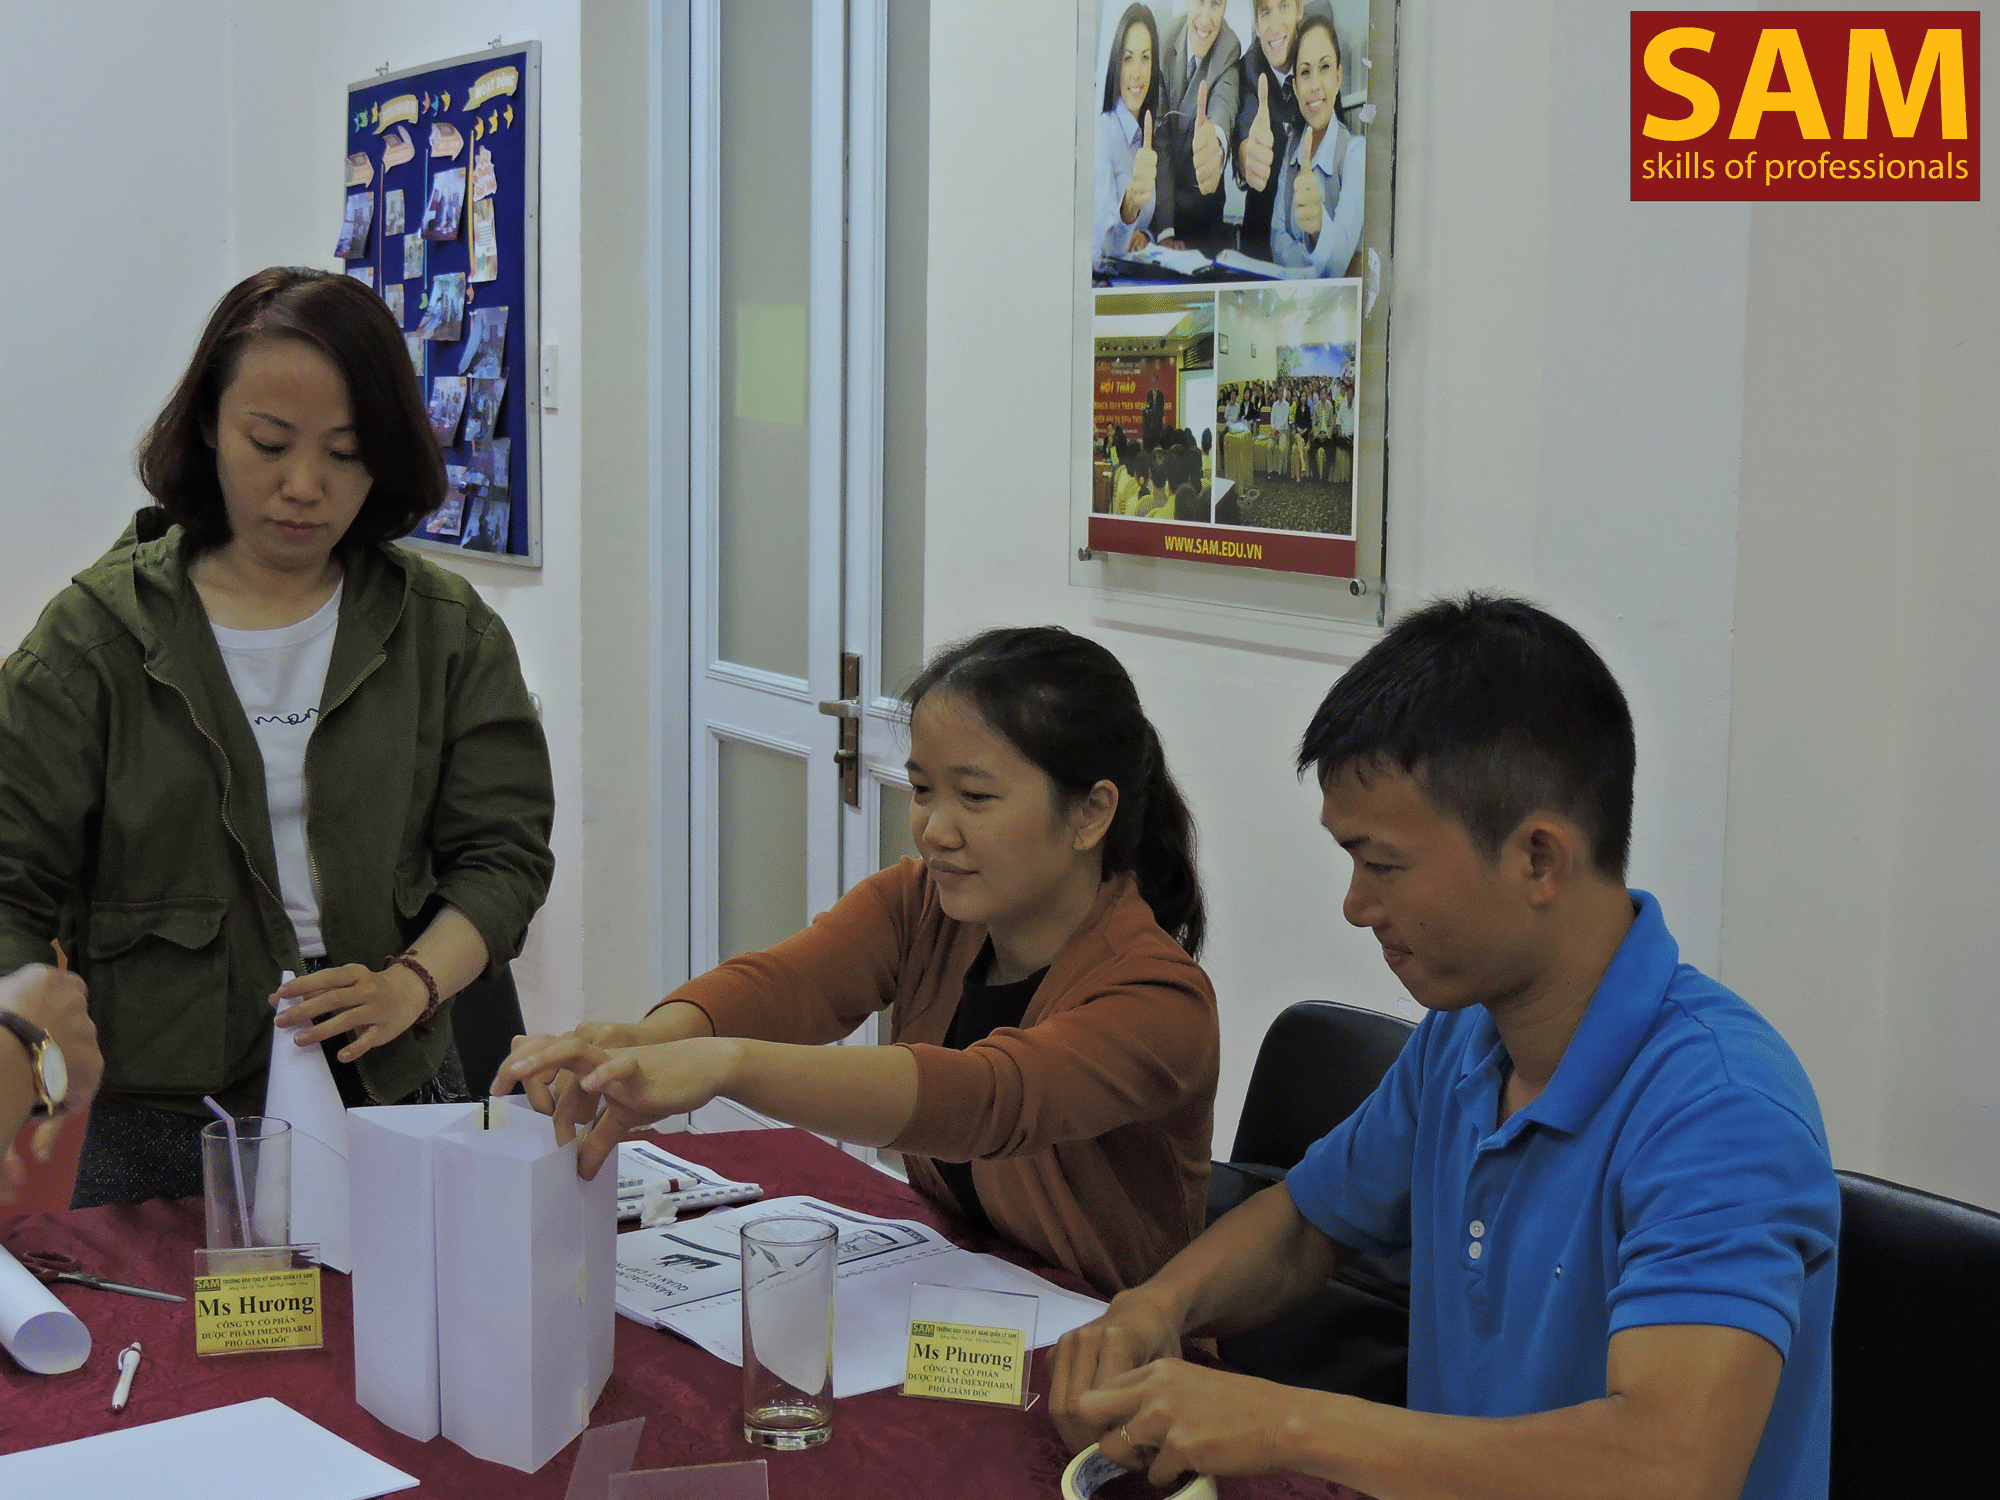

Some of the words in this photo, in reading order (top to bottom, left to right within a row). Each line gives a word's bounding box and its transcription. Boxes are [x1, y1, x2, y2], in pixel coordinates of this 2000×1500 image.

[1165, 535, 1262, 560] WWW.SAM.EDU.VN
[196, 1279, 220, 1290] SAM
[198, 1299, 231, 1318] Ms
[240, 1295, 314, 1315] Hương
[216, 1320, 242, 1329] CÔNG
[913, 1324, 934, 1335] SAM
[257, 1325, 312, 1336] IMEXPHARM
[913, 1343, 939, 1360] Ms
[946, 1346, 1012, 1371] Phương
[922, 1363, 947, 1373] CÔNG
[949, 1366, 960, 1374] TY
[960, 1378, 1013, 1390] IMEXPHARM
